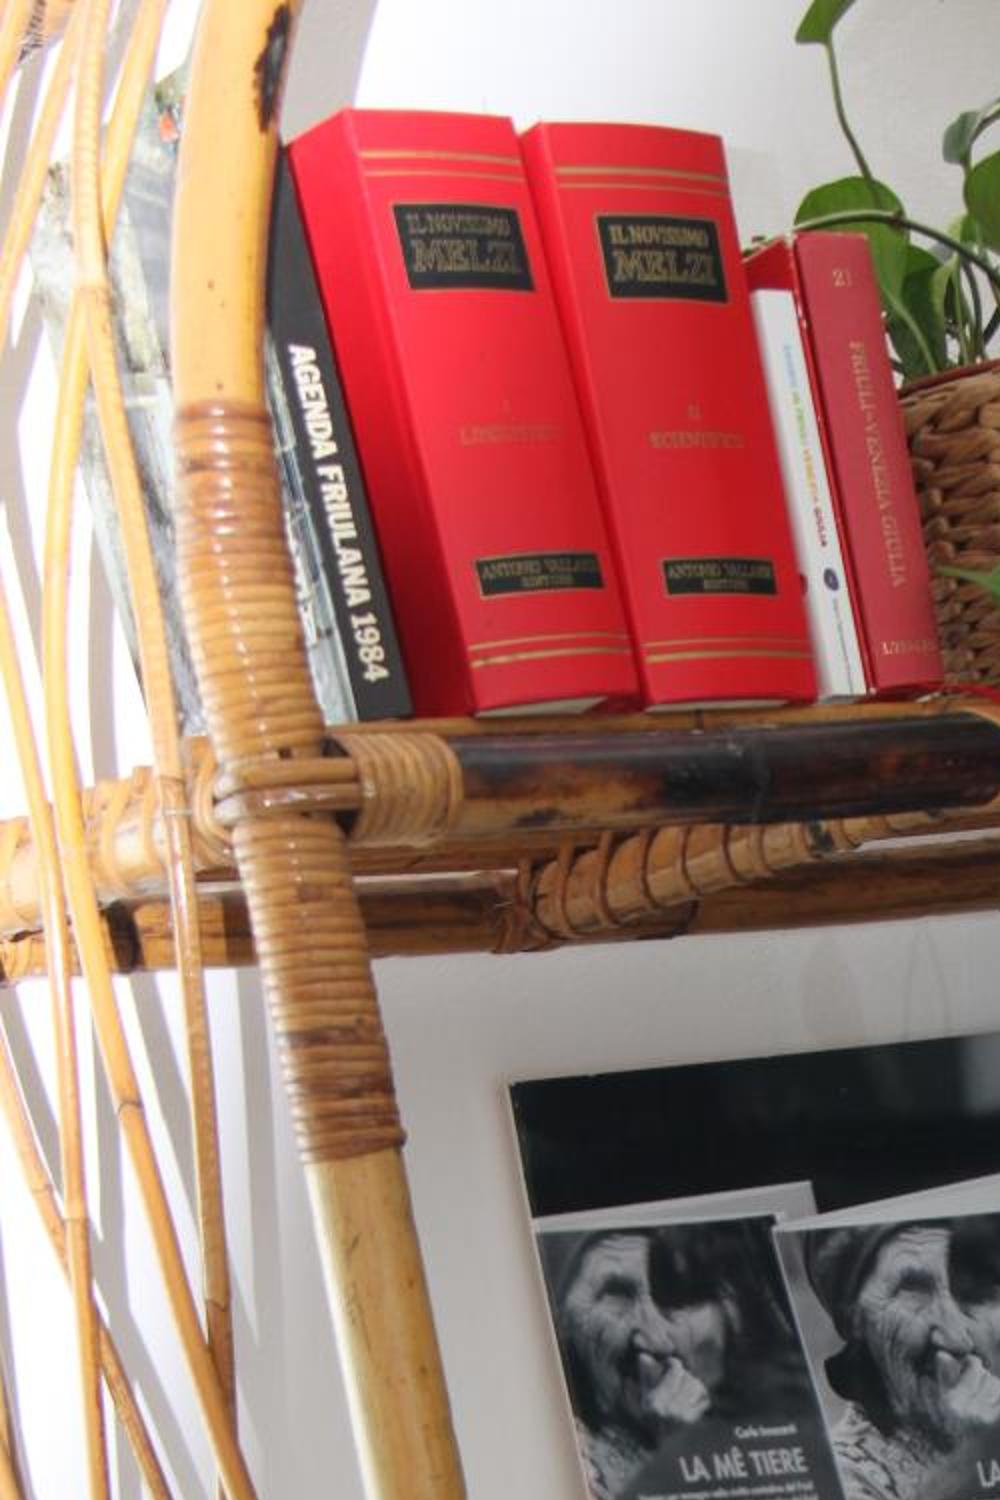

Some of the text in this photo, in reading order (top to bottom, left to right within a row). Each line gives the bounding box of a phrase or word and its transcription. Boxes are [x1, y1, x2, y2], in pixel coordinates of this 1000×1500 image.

[613, 249, 716, 285] MELZI
[288, 340, 390, 683] AGENDA FRIULANA 1984
[679, 1446, 809, 1481] LA MÊ TIERE
